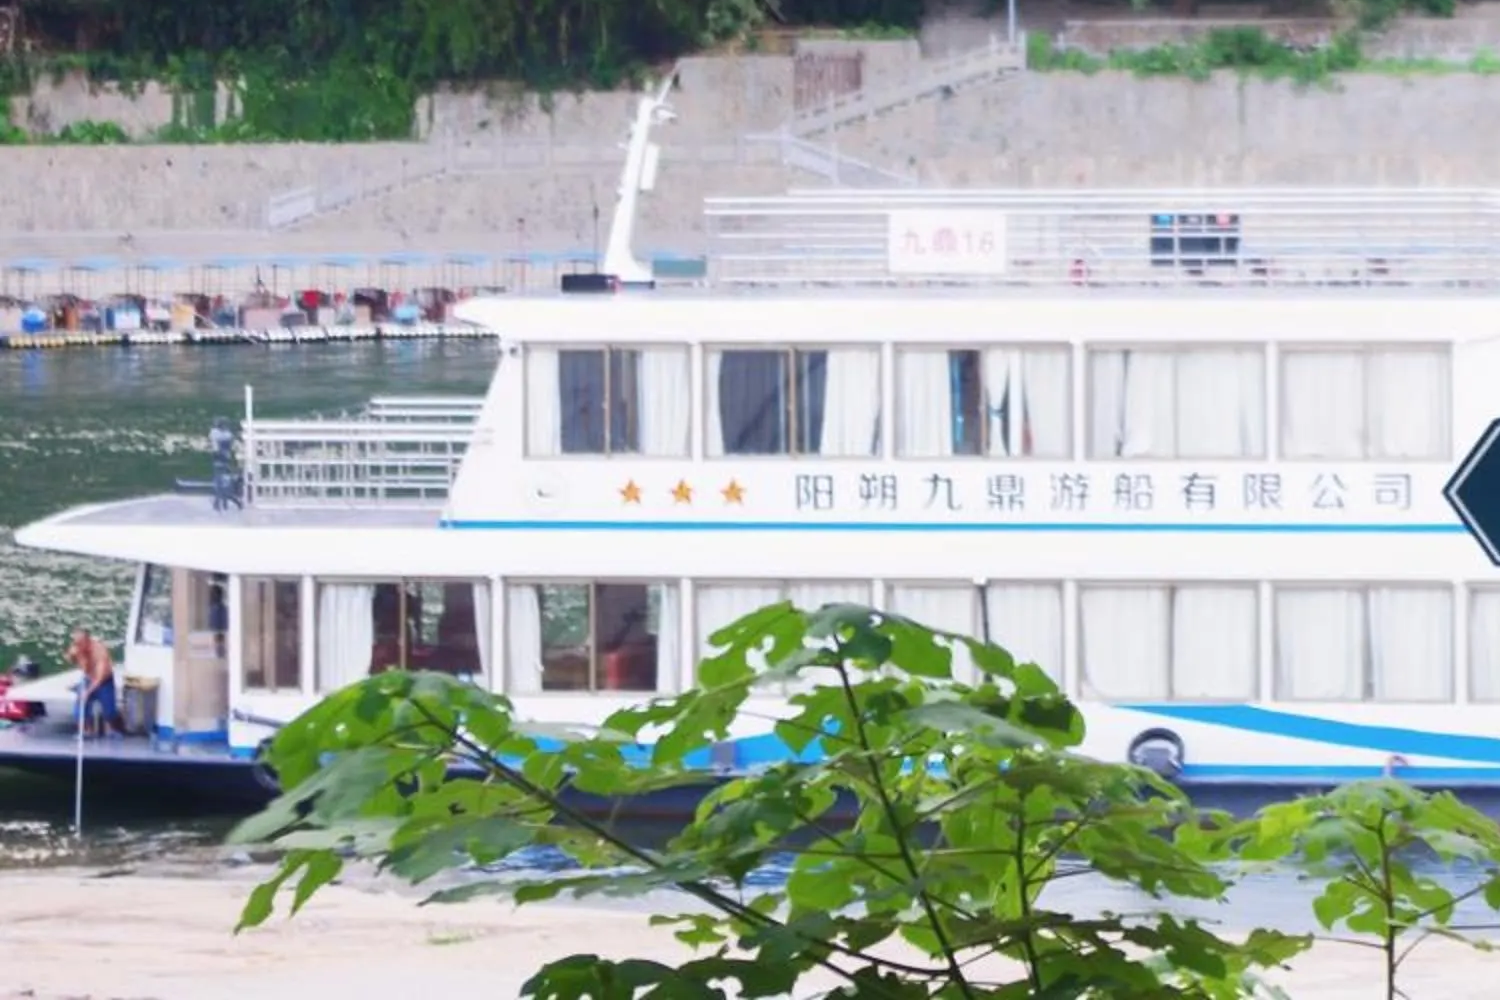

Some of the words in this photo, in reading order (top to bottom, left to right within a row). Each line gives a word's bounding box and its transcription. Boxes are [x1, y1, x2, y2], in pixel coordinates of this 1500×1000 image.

[795, 471, 1414, 513] 阳朔九鼎游船有限公司
